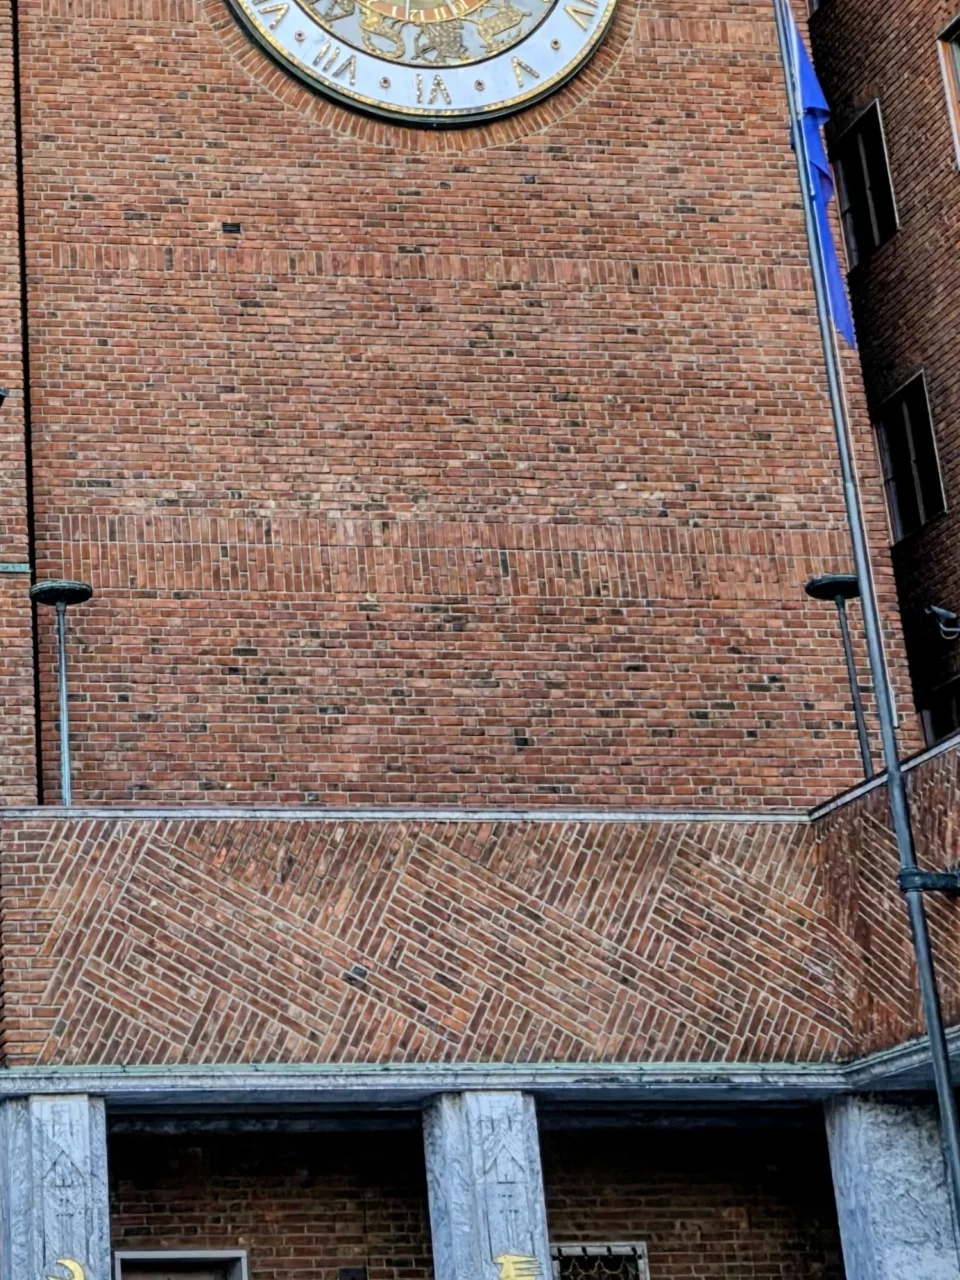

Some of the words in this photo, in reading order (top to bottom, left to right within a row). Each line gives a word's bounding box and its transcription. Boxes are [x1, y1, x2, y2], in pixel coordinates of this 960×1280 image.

[409, 9, 425, 20] 12
[312, 40, 357, 86] VII
[511, 56, 540, 88] V
[415, 73, 452, 105] VI
